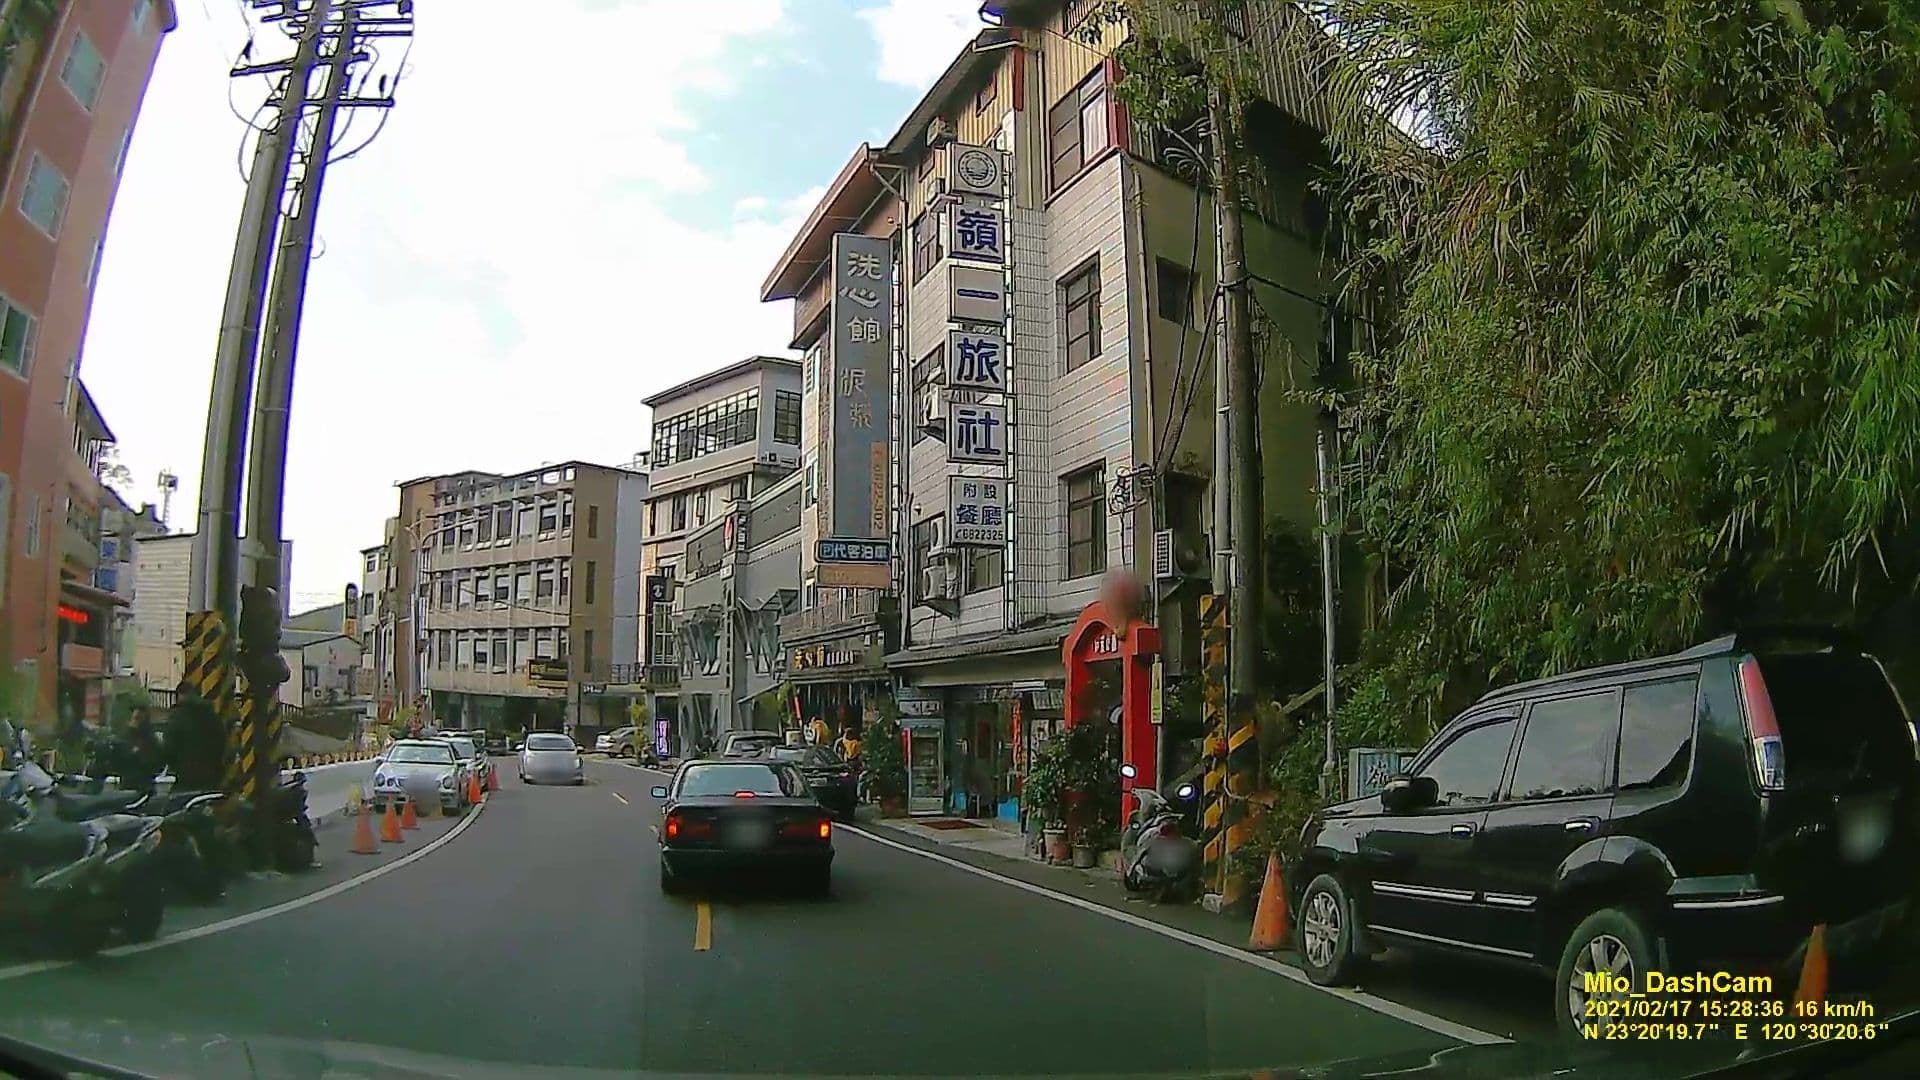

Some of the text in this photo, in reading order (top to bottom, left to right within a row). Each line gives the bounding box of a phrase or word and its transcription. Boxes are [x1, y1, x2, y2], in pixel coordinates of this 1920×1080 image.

[839, 252, 882, 343] 洗心館
[956, 210, 1000, 455] 嶺一旅社
[956, 504, 1002, 525] 餐廳
